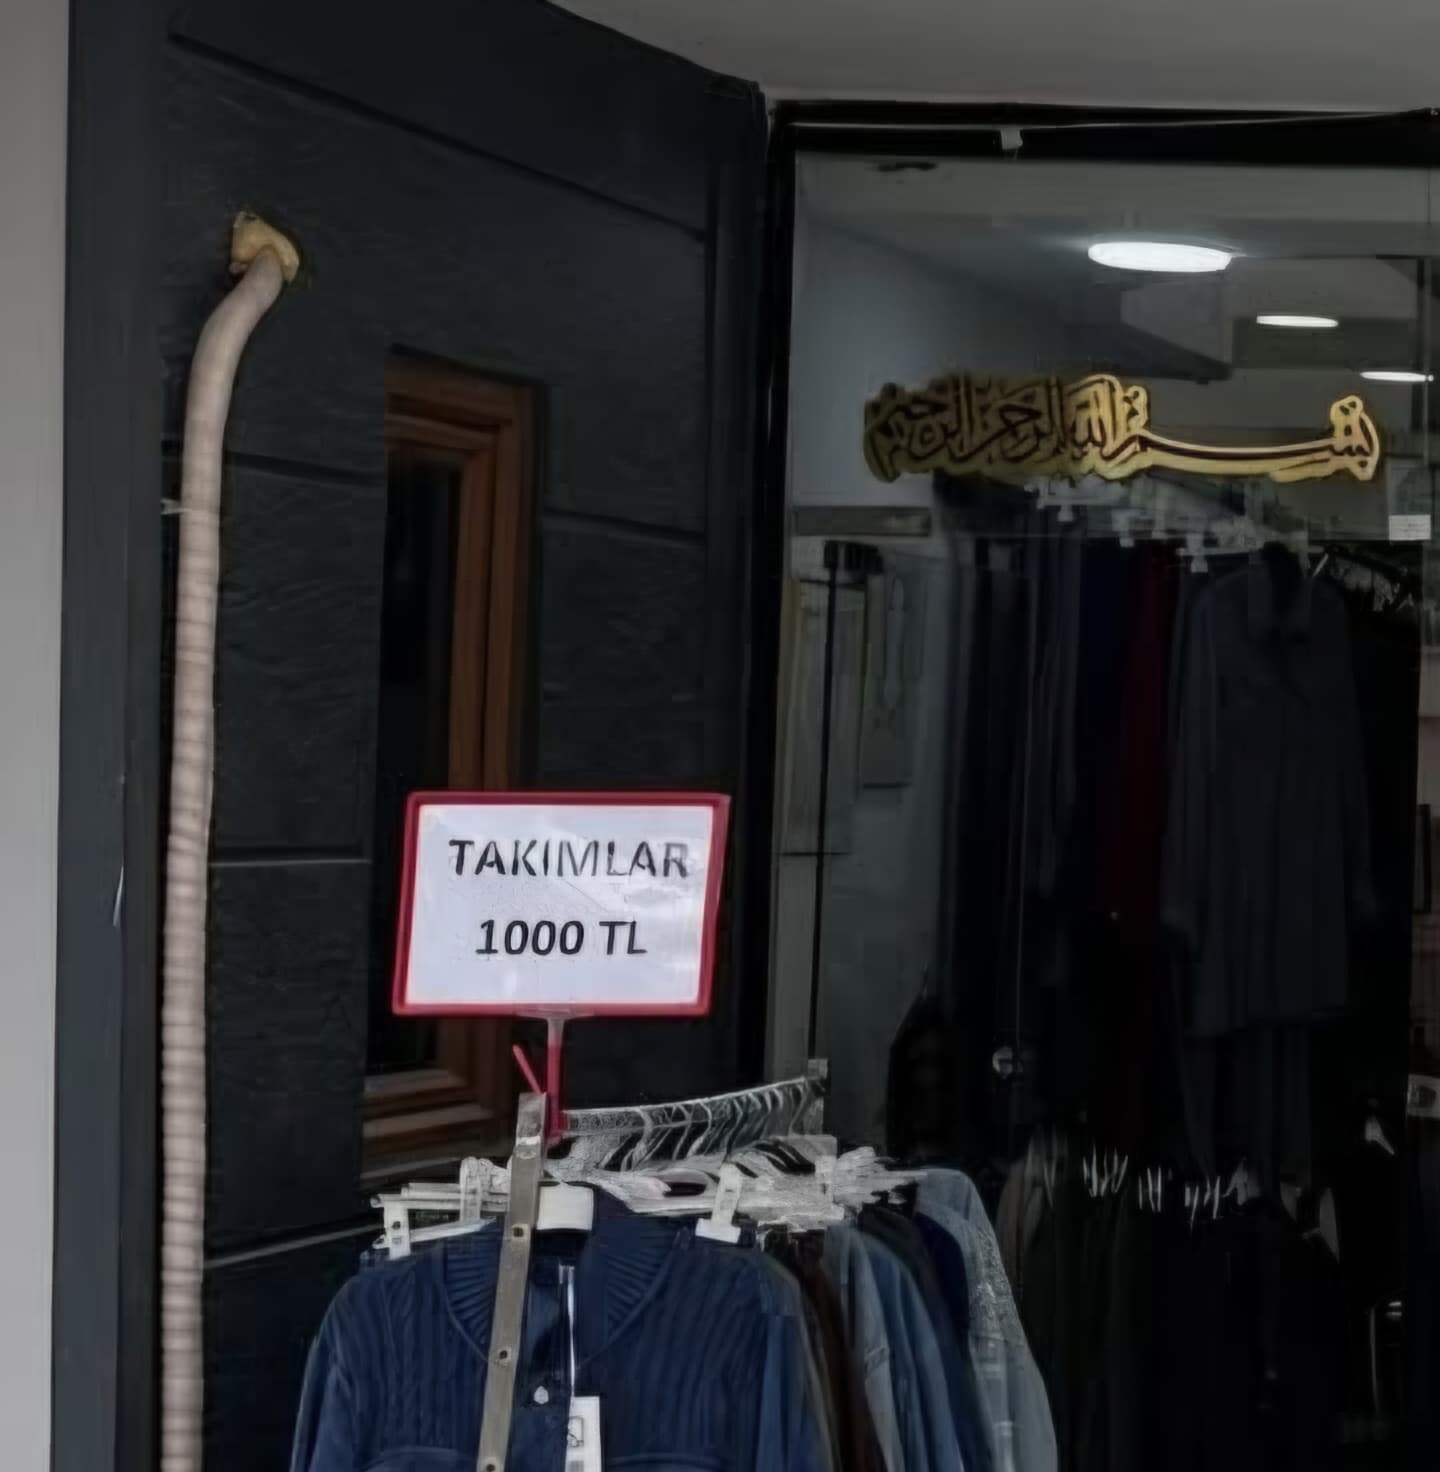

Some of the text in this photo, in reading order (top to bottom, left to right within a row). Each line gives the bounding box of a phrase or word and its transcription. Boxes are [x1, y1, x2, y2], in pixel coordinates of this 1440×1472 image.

[448, 838, 689, 878] TAKIMLAR
[475, 919, 649, 956] 1000 TL
